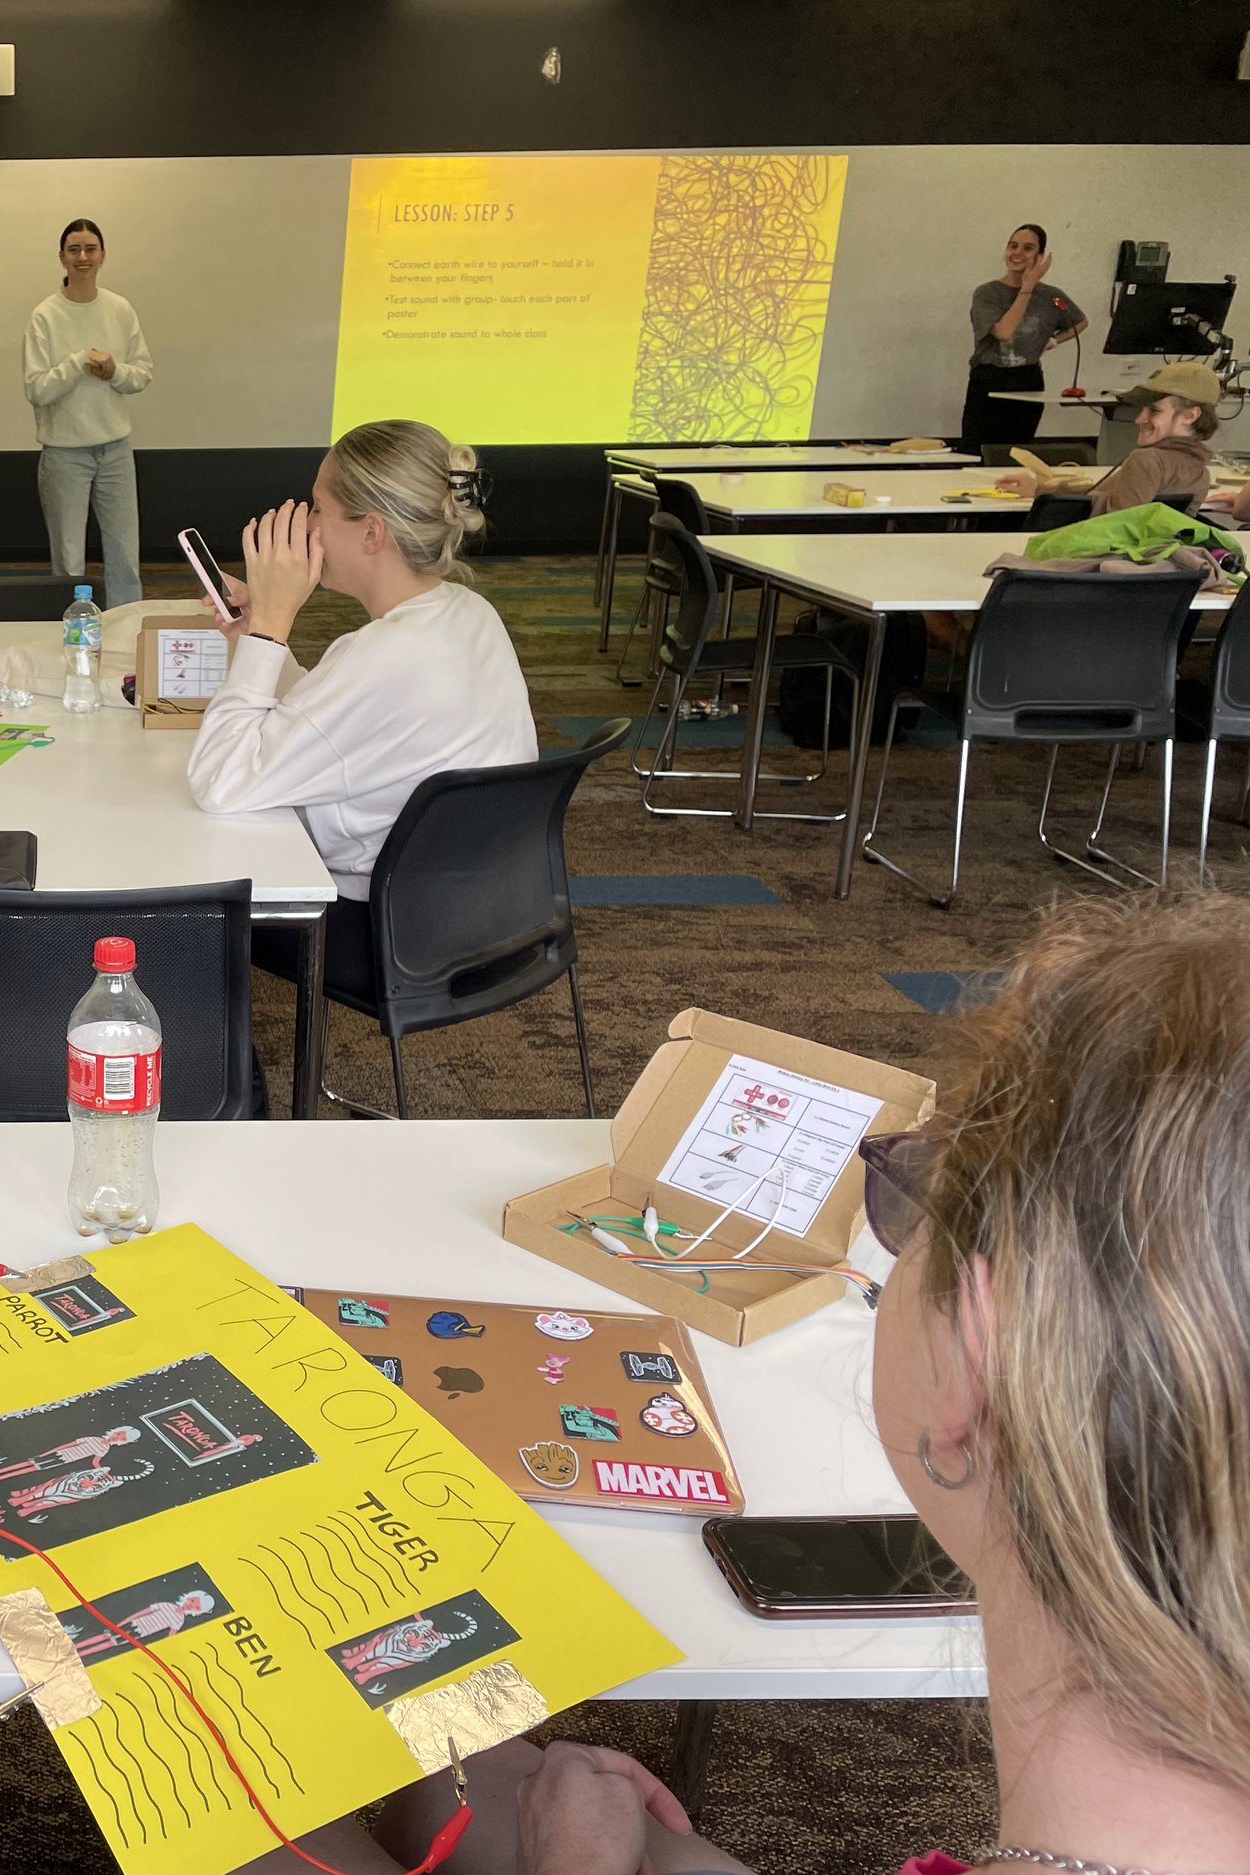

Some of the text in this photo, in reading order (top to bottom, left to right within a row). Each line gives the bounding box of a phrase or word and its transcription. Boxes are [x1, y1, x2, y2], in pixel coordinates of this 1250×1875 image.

[394, 203, 515, 222] LESSON: STEP 5
[392, 258, 594, 271] Connect earth wire to yourself hold it in
[390, 273, 493, 285] between your fingers
[389, 294, 407, 304] Test
[410, 294, 438, 304] sound
[441, 294, 461, 304] with
[501, 294, 526, 304] touch
[529, 294, 552, 304] each
[555, 294, 577, 305] part
[580, 294, 590, 303] of
[387, 310, 418, 320] poster
[386, 329, 547, 339] Demonstrate sound to whole class
[146, 1055, 154, 1070] ME
[168, 1410, 218, 1450] TARONGA
[195, 1277, 518, 1573] TARONGA
[596, 1461, 727, 1502] MARVEL
[356, 1492, 439, 1573] TIGER
[223, 1614, 280, 1679] BEN
